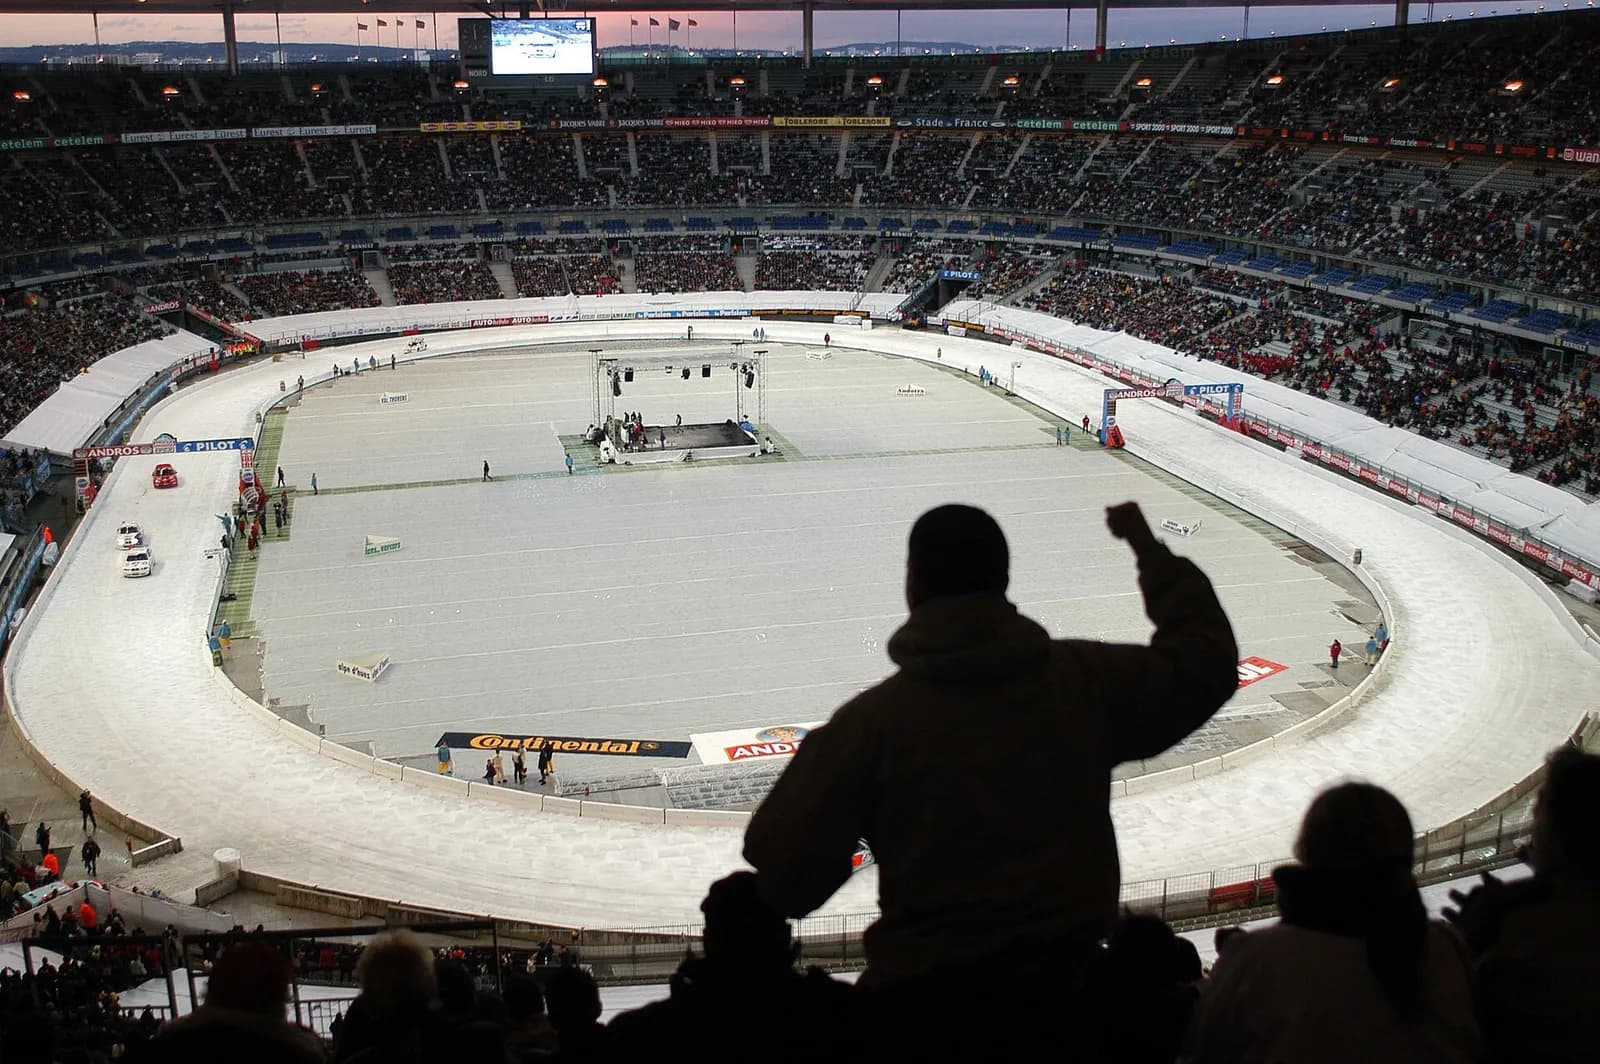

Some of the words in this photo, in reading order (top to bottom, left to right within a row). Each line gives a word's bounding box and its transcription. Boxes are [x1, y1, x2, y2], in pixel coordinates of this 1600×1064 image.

[560, 120, 586, 129] JACQUES
[618, 119, 645, 128] JACQUES
[674, 119, 690, 127] MIKO
[784, 117, 828, 126] TOBLERONE
[842, 117, 887, 126] TOBLERONE
[916, 118, 944, 128] Stade
[954, 118, 989, 128] France
[1017, 119, 1062, 129] cetelem
[1073, 121, 1118, 131] cetelem
[255, 128, 283, 138] Eurest
[300, 126, 328, 136] Eurest
[345, 125, 373, 134] Eurest
[1135, 122, 1151, 131] SPORT
[1151, 123, 1165, 131] 2000
[1170, 124, 1186, 132] SPORT
[1186, 124, 1200, 133] 2000
[1205, 125, 1221, 134] SPORT
[1221, 126, 1234, 135] 2000
[1, 139, 44, 150] etelem
[54, 135, 104, 147] cetelem
[1576, 151, 1600, 164] wan
[951, 270, 972, 279] PILOT
[150, 301, 180, 313] ANDROS
[1118, 389, 1157, 399] ANDROS
[1200, 385, 1230, 395] PILOT
[196, 440, 239, 451] PILOT
[88, 446, 139, 458] ANDROS
[1525, 544, 1547, 561] ANDROS
[1563, 562, 1587, 581] ANDROS
[338, 662, 351, 674] alpe
[469, 733, 641, 754] Continental
